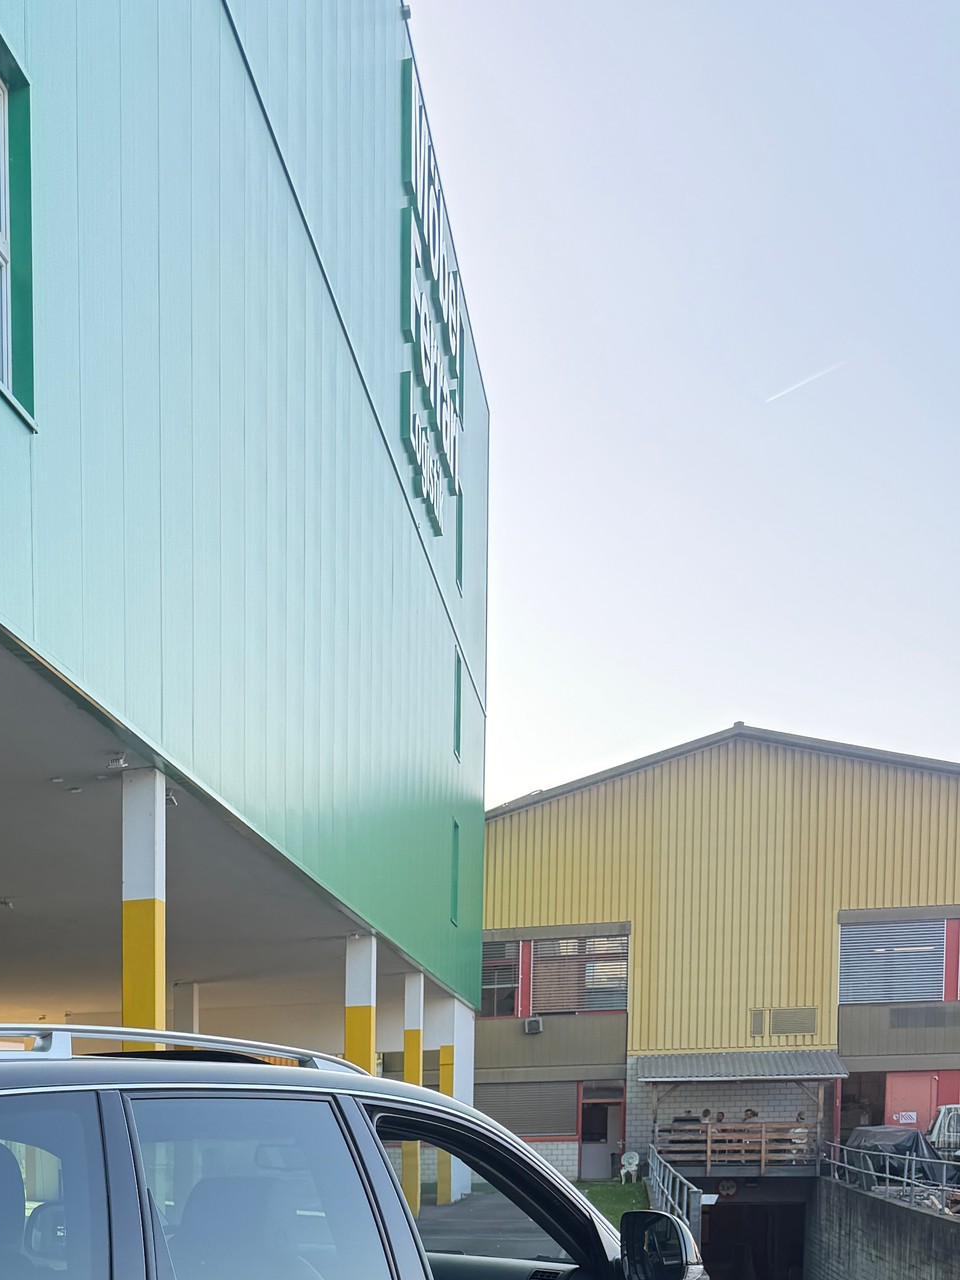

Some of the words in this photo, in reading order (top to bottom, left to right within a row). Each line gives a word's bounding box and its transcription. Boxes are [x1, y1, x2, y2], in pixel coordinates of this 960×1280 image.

[410, 57, 460, 378] Möbel
[410, 205, 460, 496] Ferrari
[410, 371, 444, 537] Logistik
